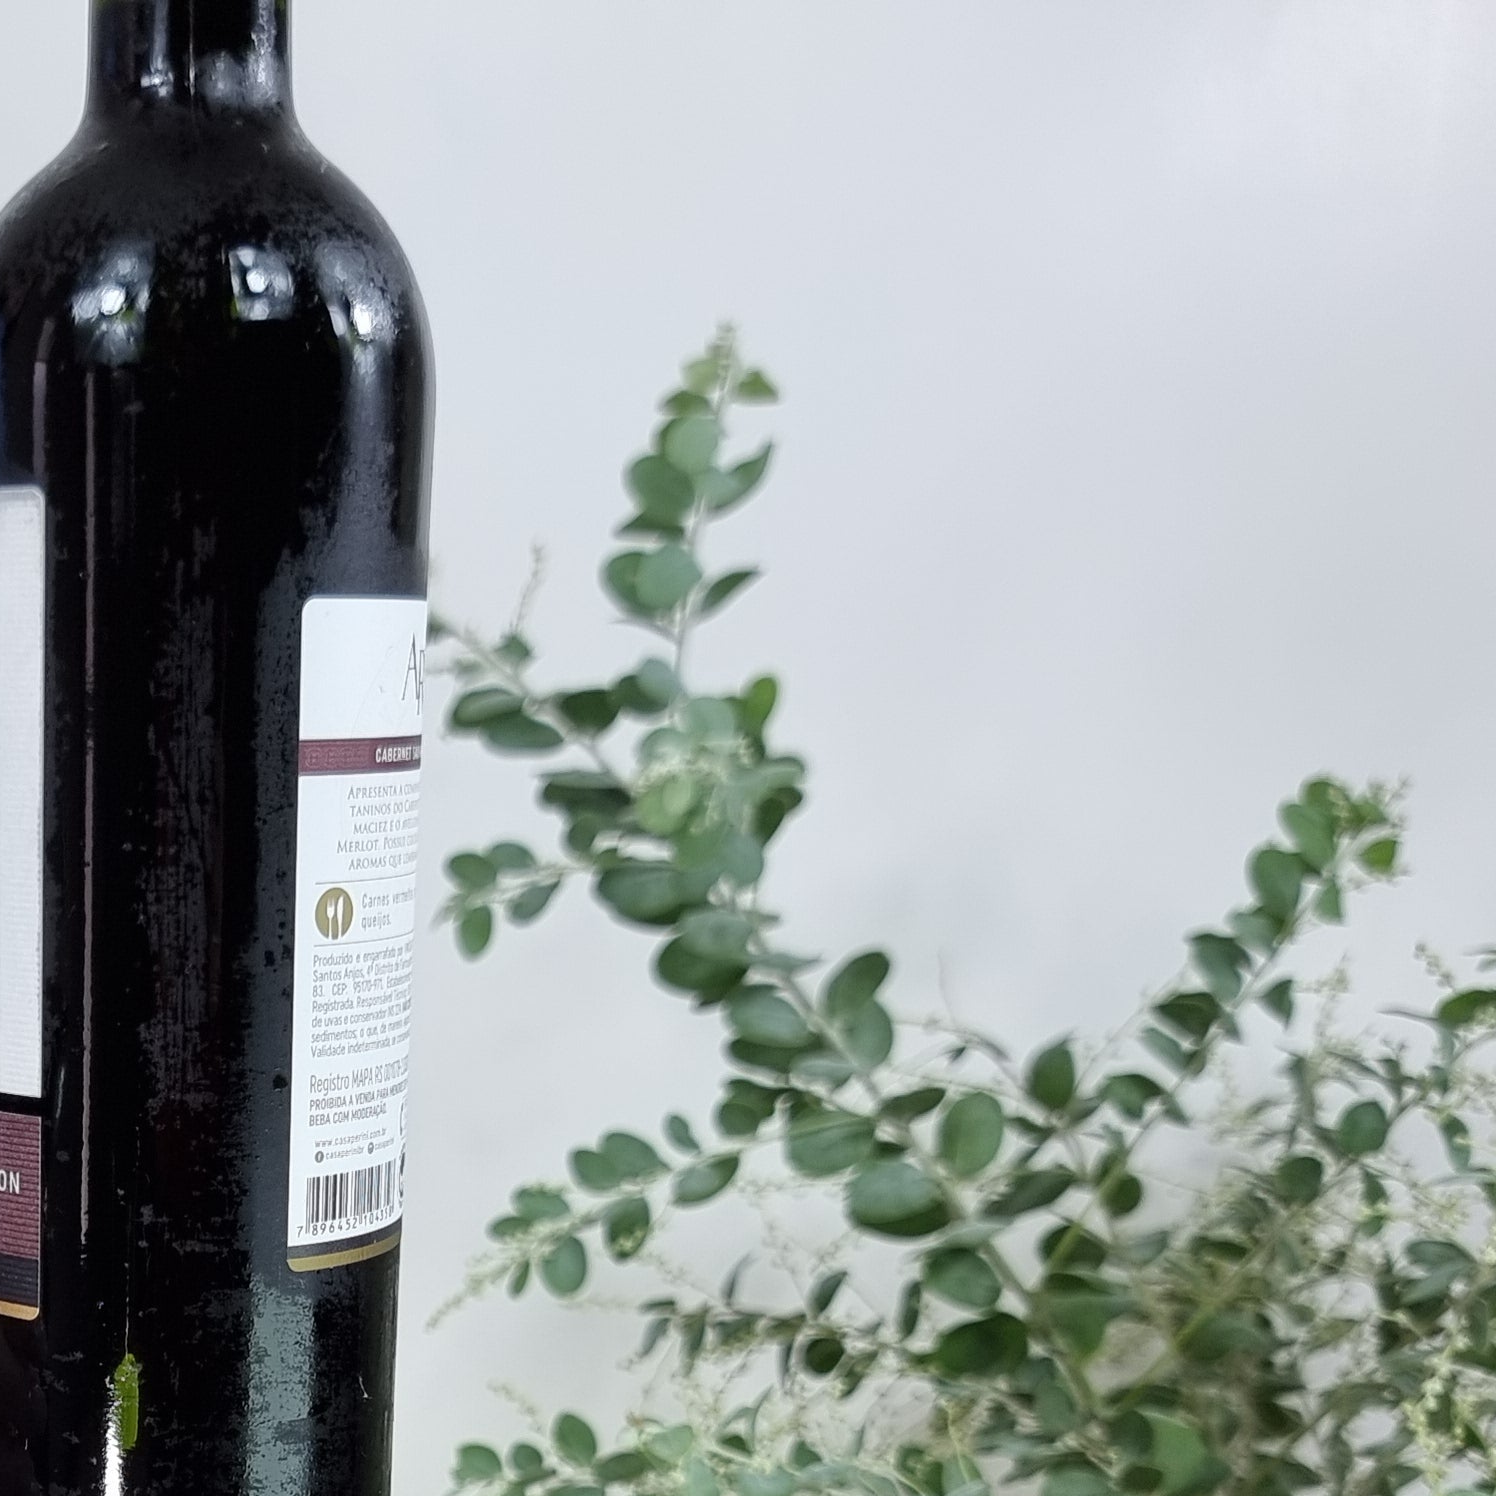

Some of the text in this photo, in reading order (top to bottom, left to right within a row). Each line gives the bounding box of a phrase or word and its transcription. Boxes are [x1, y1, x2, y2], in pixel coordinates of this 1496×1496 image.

[376, 746, 411, 763] CABERNET
[347, 786, 396, 800] APRESENTA
[350, 803, 391, 817] TANINOS
[353, 821, 387, 835] MACIEZ
[348, 856, 386, 870] AROMAS
[362, 893, 389, 908] Carnes
[313, 953, 353, 967] Produzido
[313, 969, 342, 982] Santos
[312, 1016, 322, 1028] de
[311, 1044, 345, 1058] Validade
[310, 1074, 349, 1096] Registro
[352, 1067, 373, 1088] MAPA
[310, 1095, 346, 1111] PROIBIDA
[309, 1113, 330, 1126] BEBA
[333, 1110, 349, 1123] COM
[312, 1218, 357, 1236] 896452
